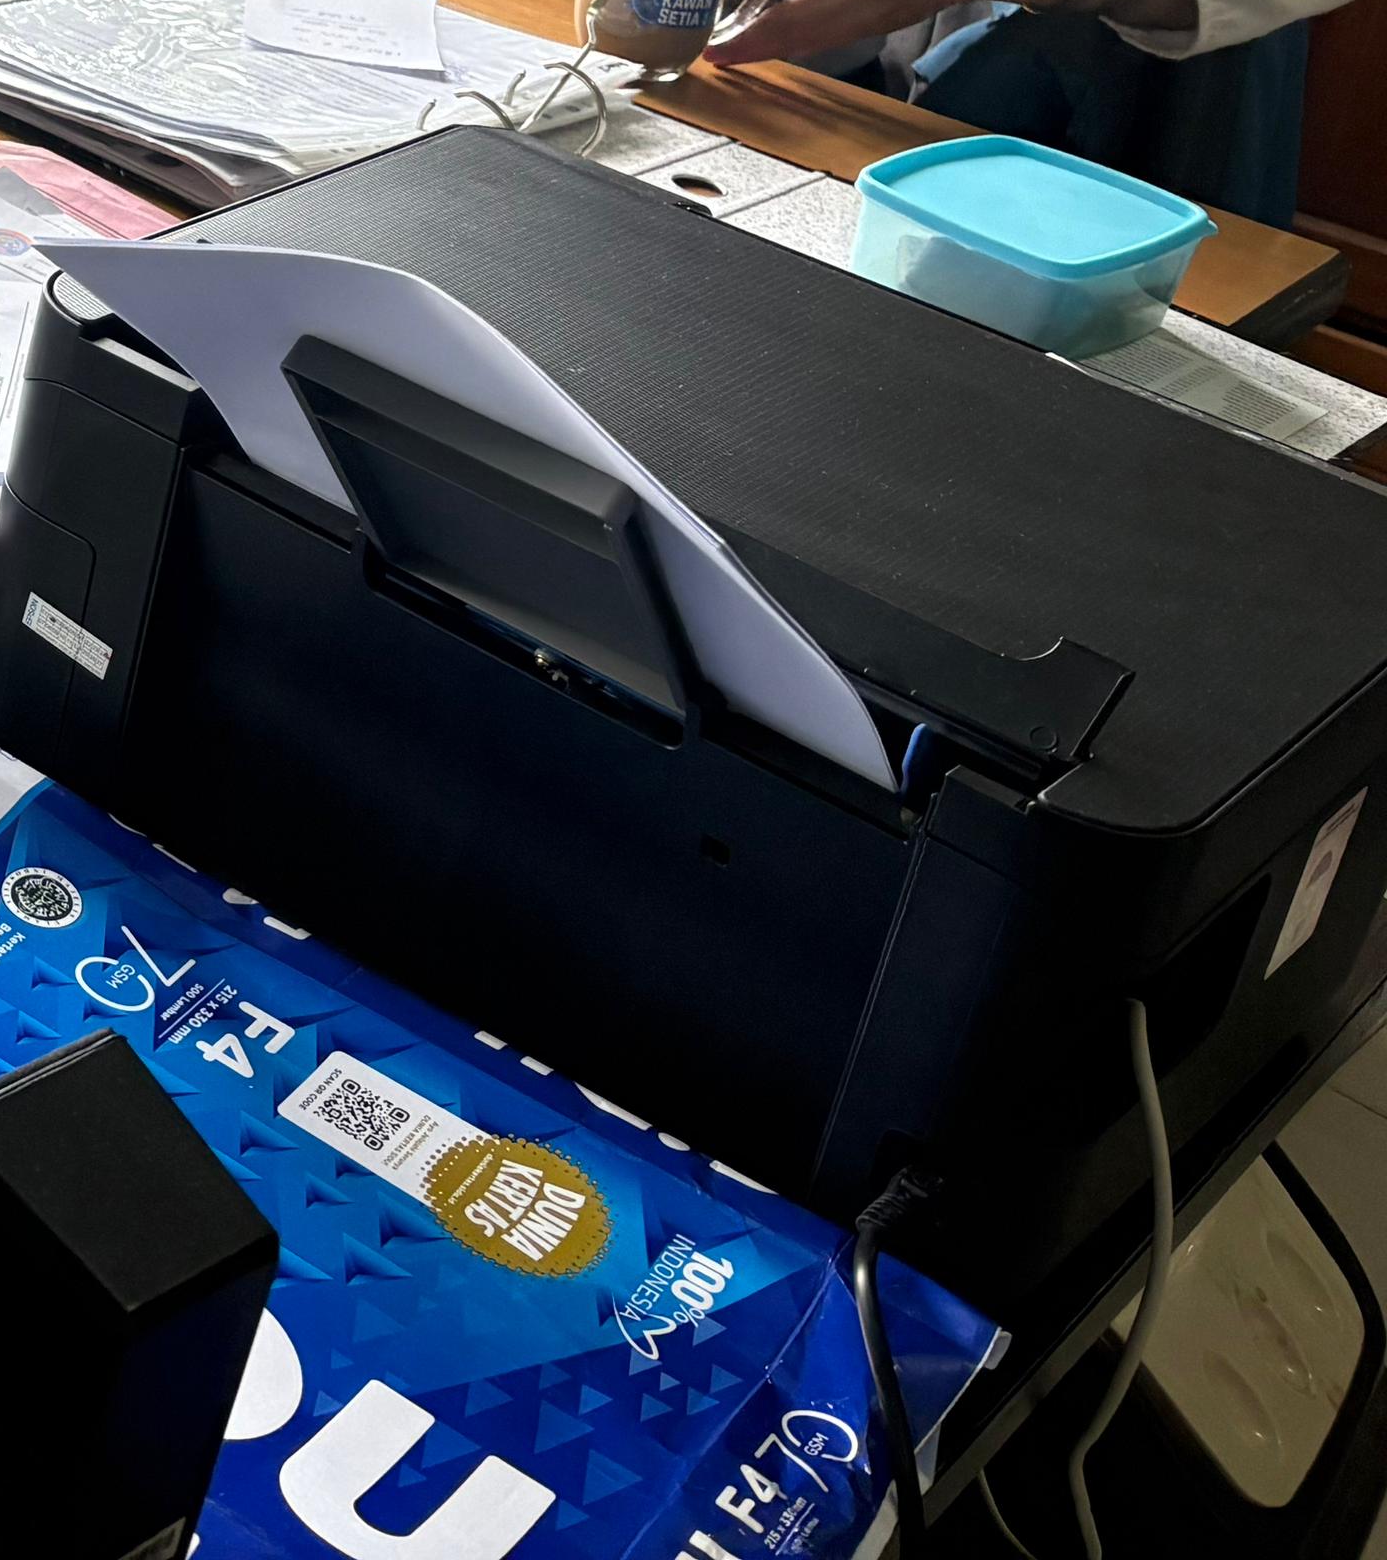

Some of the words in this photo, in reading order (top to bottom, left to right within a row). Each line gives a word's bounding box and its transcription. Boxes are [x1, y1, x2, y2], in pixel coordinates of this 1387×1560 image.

[105, 963, 136, 989] GSM
[183, 982, 205, 1000] 500
[214, 984, 239, 1006] 215
[159, 991, 191, 1022] Lembar
[187, 1007, 215, 1029] 330
[206, 999, 220, 1011] x
[167, 1023, 193, 1045] mm
[195, 1000, 296, 1079] F4
[322, 1067, 343, 1088] SCAN
[298, 1091, 319, 1111] CODE
[464, 1159, 545, 1238] KERTAS
[500, 1182, 587, 1262] DUNIA
[618, 1232, 697, 1321] INDONESIA
[670, 1250, 735, 1329] 100%
[803, 1431, 830, 1457] GSM
[715, 1463, 789, 1535] F4
